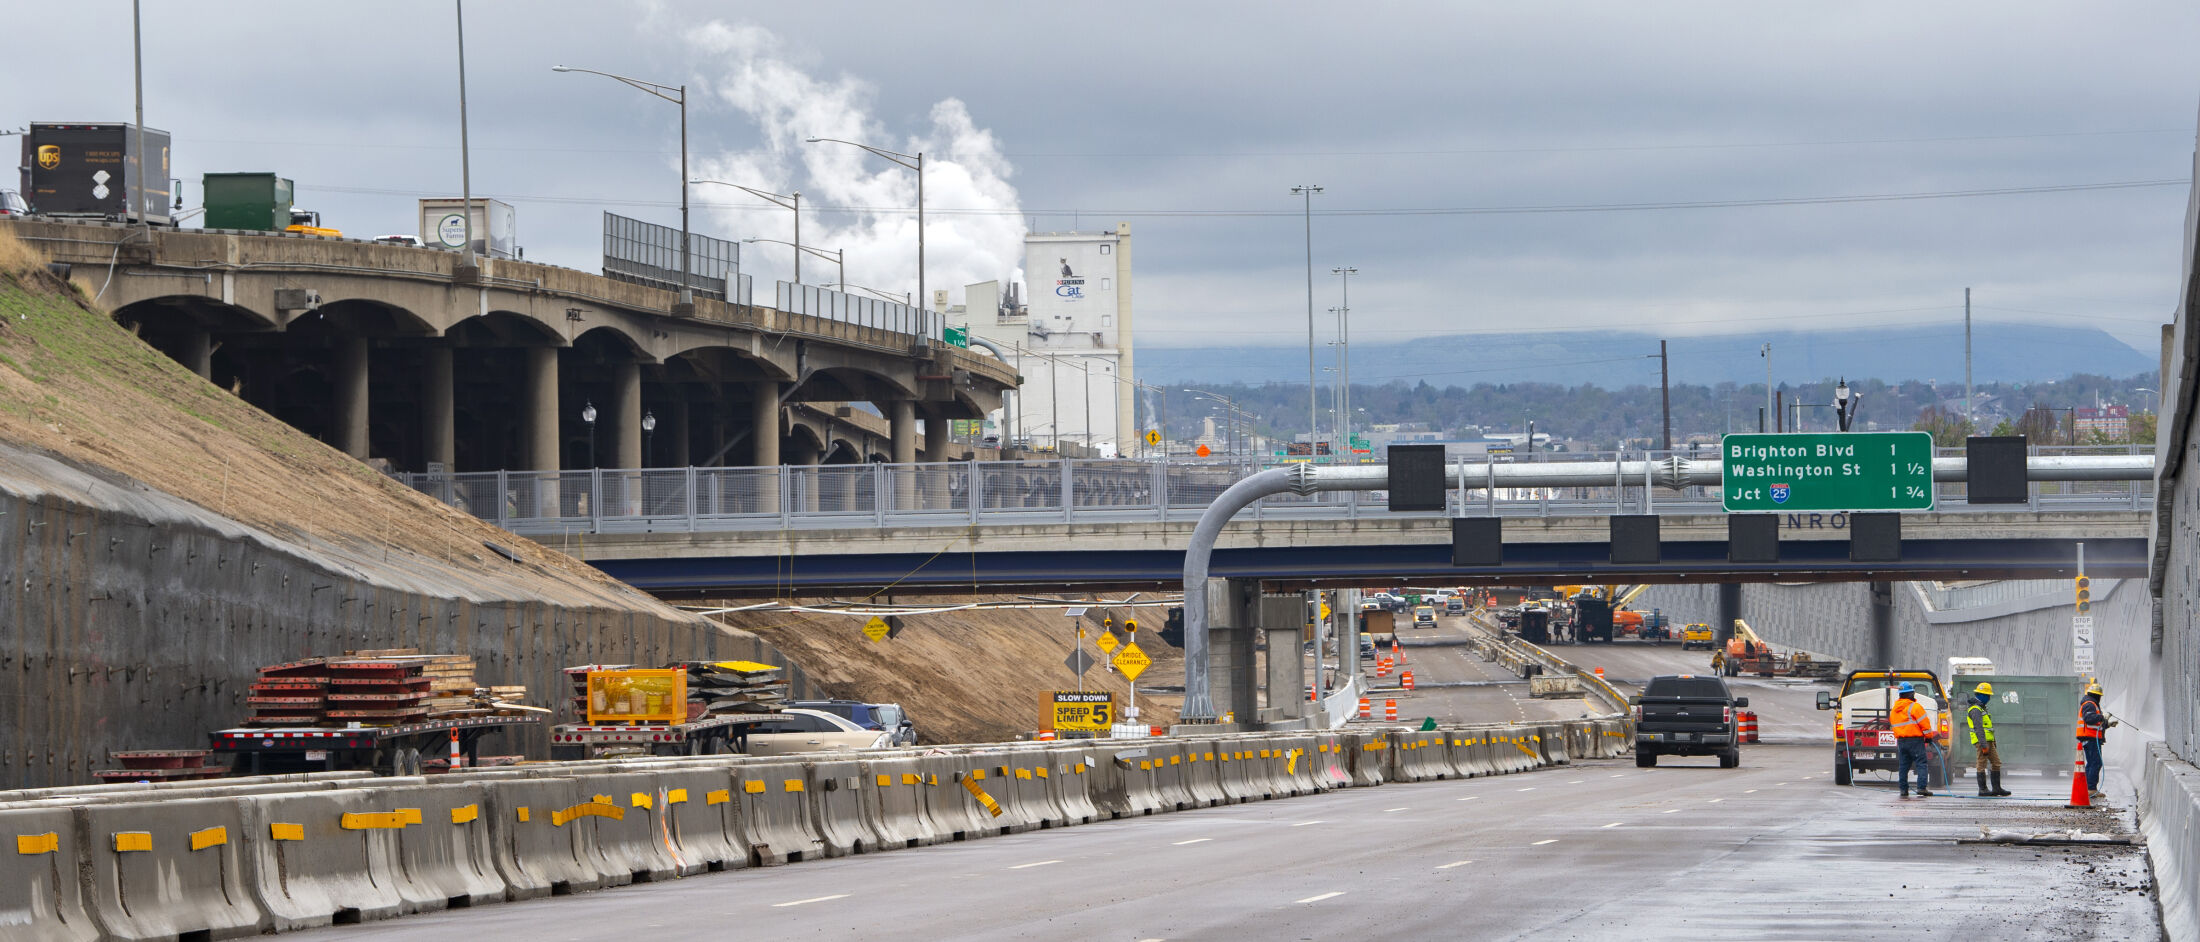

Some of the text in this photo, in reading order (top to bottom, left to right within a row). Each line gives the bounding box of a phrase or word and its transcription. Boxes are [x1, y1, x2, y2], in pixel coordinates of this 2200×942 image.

[40, 153, 58, 166] ups
[1056, 285, 1080, 297] Cat
[1731, 443, 1896, 462] Brighton Blvd 1
[1732, 464, 1833, 480] Washington
[1842, 463, 1861, 476] St
[1891, 463, 1896, 476] 1
[1733, 487, 1761, 500] Jct
[1773, 488, 1787, 499] 25
[1891, 486, 1896, 499] 1
[1057, 694, 1081, 702] SLOW
[1057, 704, 1109, 725] SPEED 5
